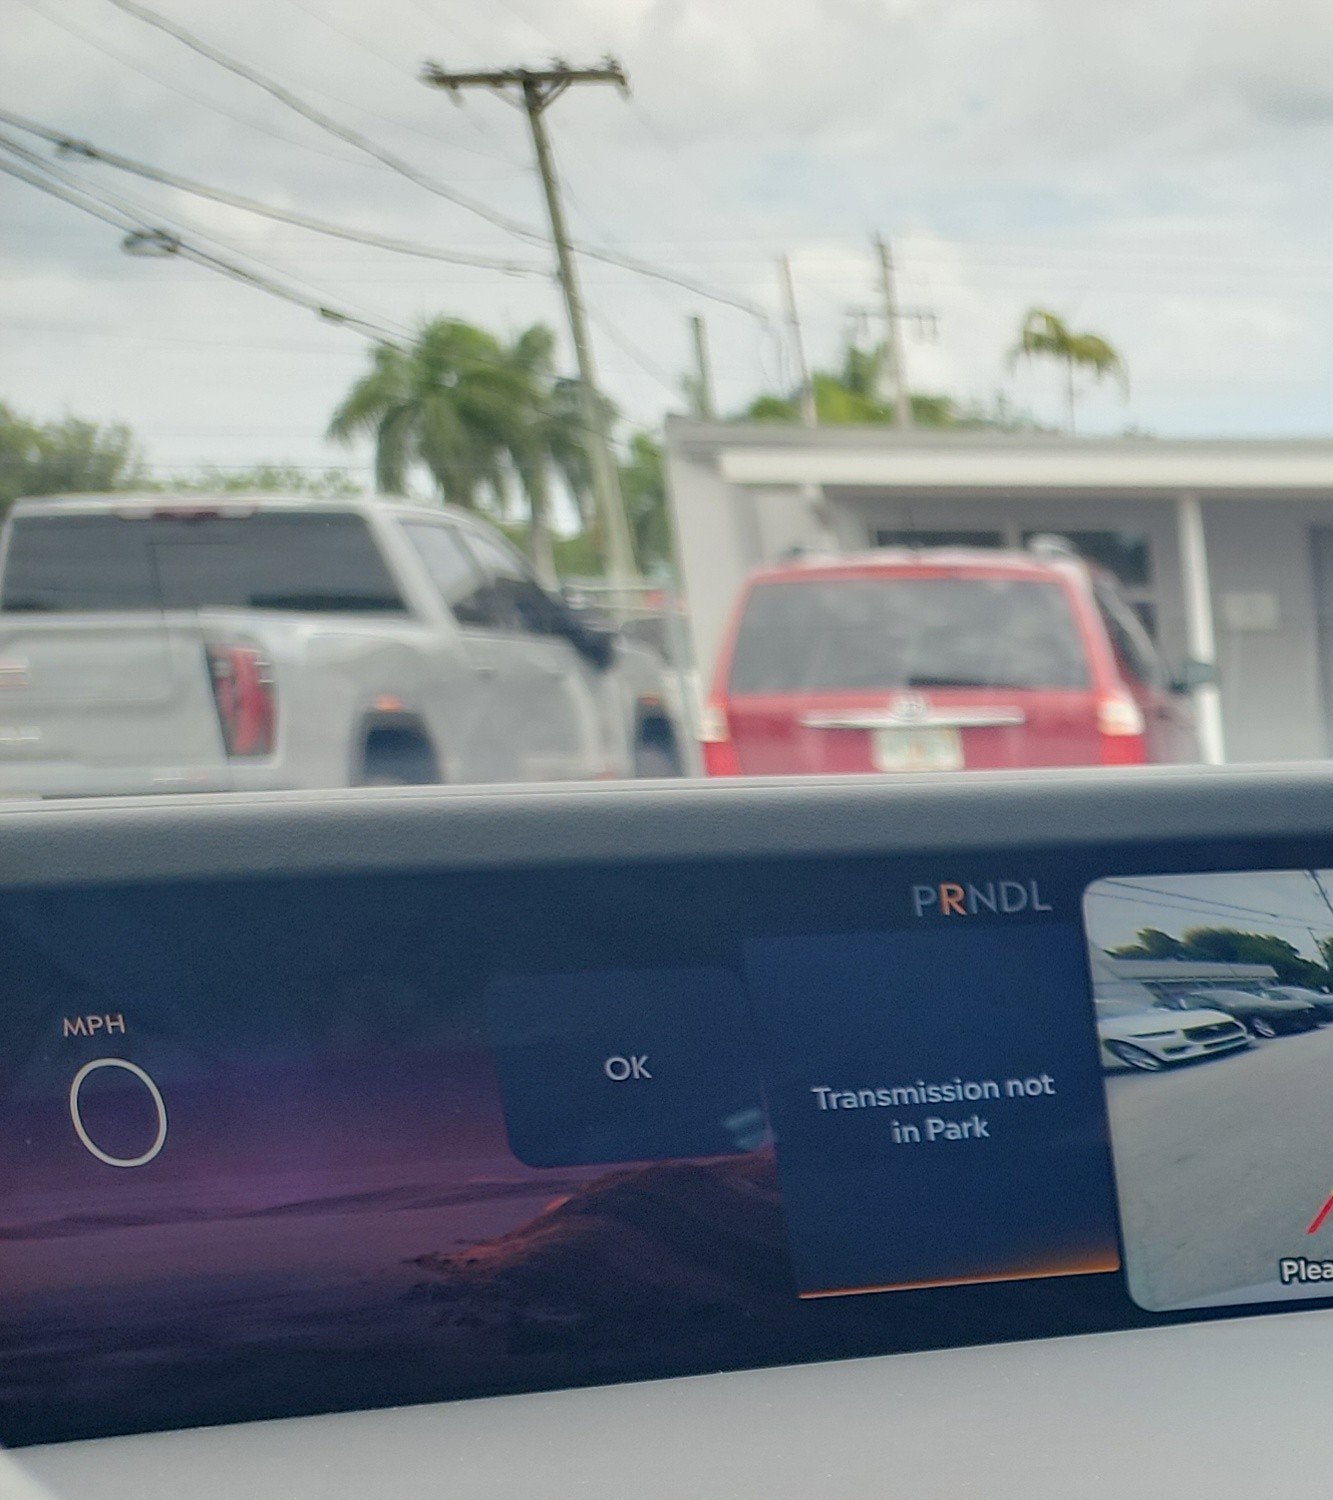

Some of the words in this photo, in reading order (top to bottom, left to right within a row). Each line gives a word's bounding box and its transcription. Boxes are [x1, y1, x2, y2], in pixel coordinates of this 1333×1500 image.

[913, 880, 1052, 917] PRNDL
[62, 1014, 126, 1038] MPH
[604, 1054, 652, 1082] OK
[811, 1078, 999, 1110] Transmission
[1006, 1073, 1056, 1099] not
[891, 1118, 920, 1144] in
[926, 1114, 990, 1142] Park
